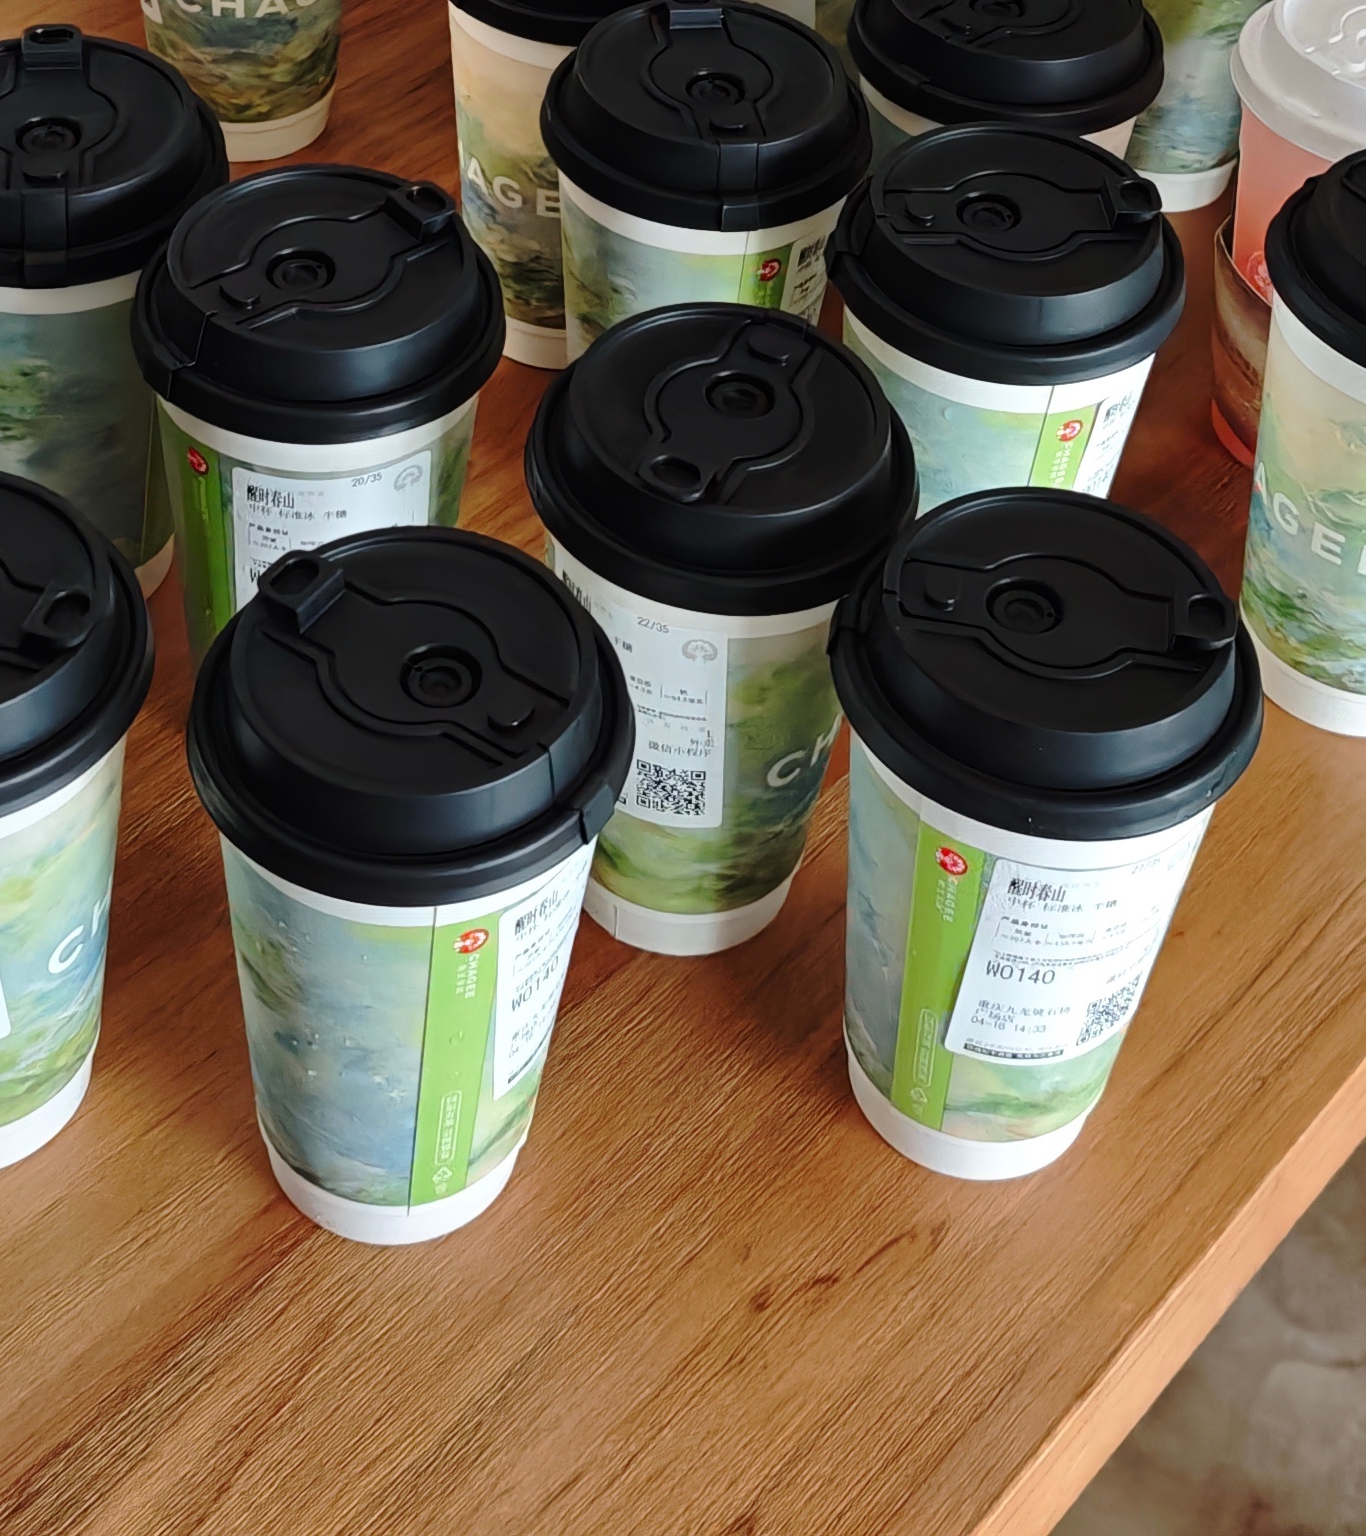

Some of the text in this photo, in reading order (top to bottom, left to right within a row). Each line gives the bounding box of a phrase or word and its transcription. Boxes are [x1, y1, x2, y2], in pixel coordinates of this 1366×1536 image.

[458, 140, 561, 218] AGE
[351, 472, 383, 488] 20/35
[636, 616, 670, 634] 22/35
[1006, 877, 1067, 903] 醒时春山
[511, 955, 560, 1013] W0140
[985, 959, 1056, 985] W0140
